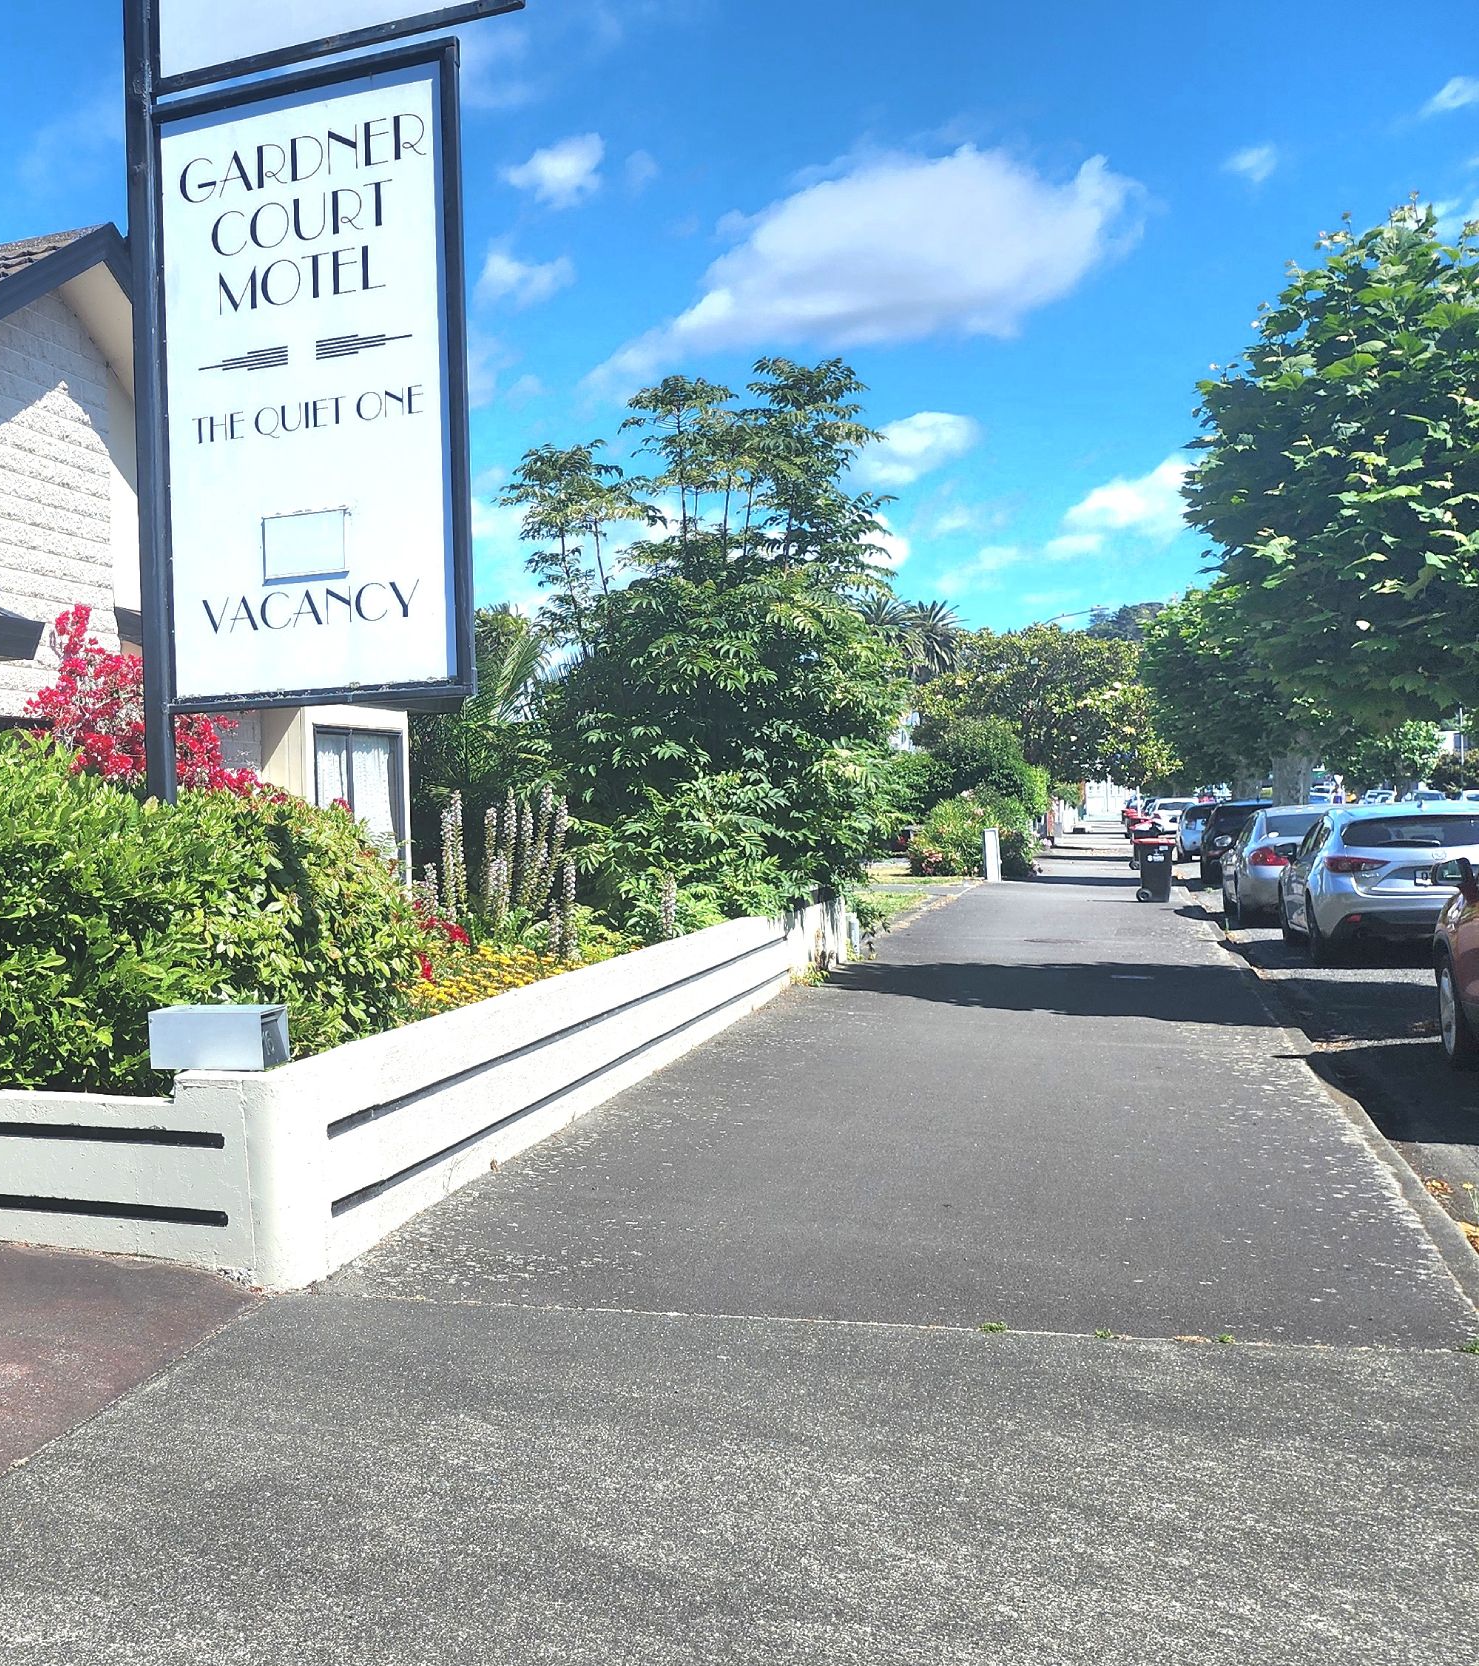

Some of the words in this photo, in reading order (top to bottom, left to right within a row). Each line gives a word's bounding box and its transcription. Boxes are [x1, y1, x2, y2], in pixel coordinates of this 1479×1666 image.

[179, 113, 428, 204] GARDNER
[210, 178, 393, 257] COURT
[218, 244, 387, 316] MOTEL
[191, 410, 246, 445] THE
[253, 395, 346, 439] QUIET
[355, 383, 424, 422] ONE
[201, 578, 420, 635] VACANCY
